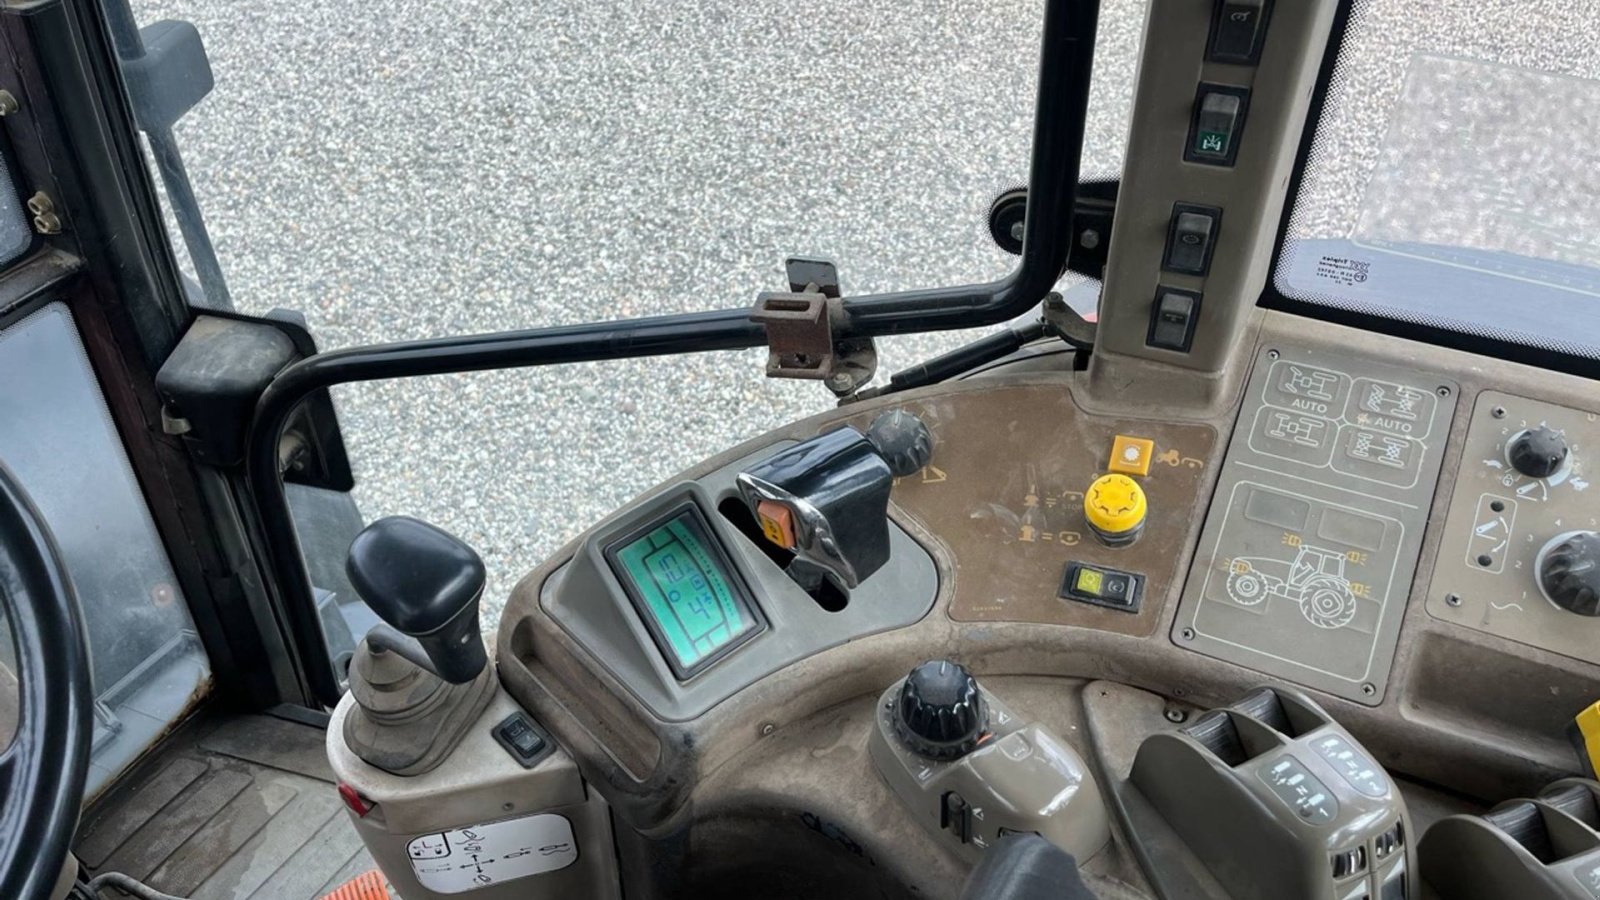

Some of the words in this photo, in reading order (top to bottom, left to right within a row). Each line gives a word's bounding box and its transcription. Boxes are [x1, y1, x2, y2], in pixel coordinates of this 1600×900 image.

[1292, 398, 1327, 414] AUTO
[1375, 417, 1412, 433] AUTO
[1502, 427, 1509, 435] 2
[1527, 533, 1533, 542] 3
[1514, 560, 1522, 569] 2
